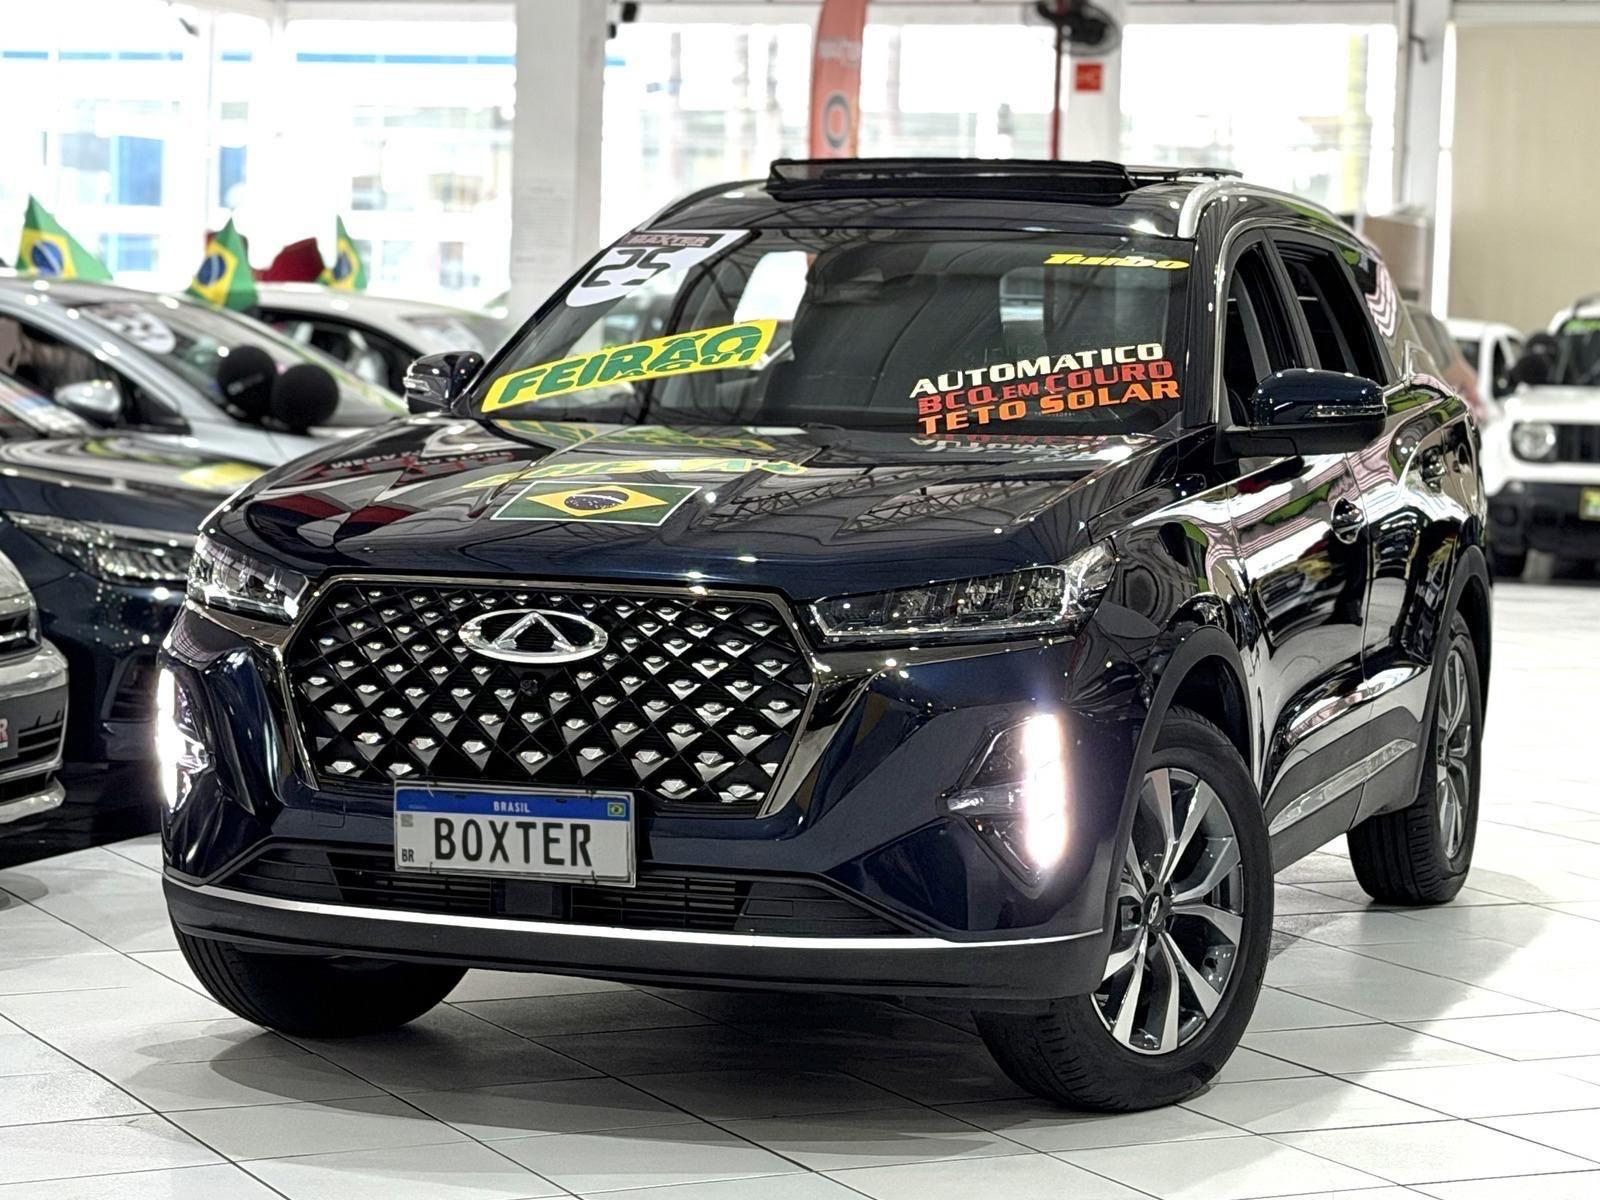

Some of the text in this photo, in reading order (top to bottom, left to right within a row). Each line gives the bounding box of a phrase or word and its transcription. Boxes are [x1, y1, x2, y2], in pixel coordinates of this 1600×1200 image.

[581, 247, 687, 288] 25
[1043, 253, 1190, 269] Turbo
[498, 325, 763, 404] FEIRÃO
[909, 343, 1164, 399] AUTOMATICO
[1002, 382, 1040, 401] EM
[1044, 360, 1174, 394] COURO
[917, 380, 1181, 435] TETO SOLAR
[493, 800, 531, 814] BRASIL
[401, 848, 415, 863] BR
[433, 817, 592, 867] BOXTER
